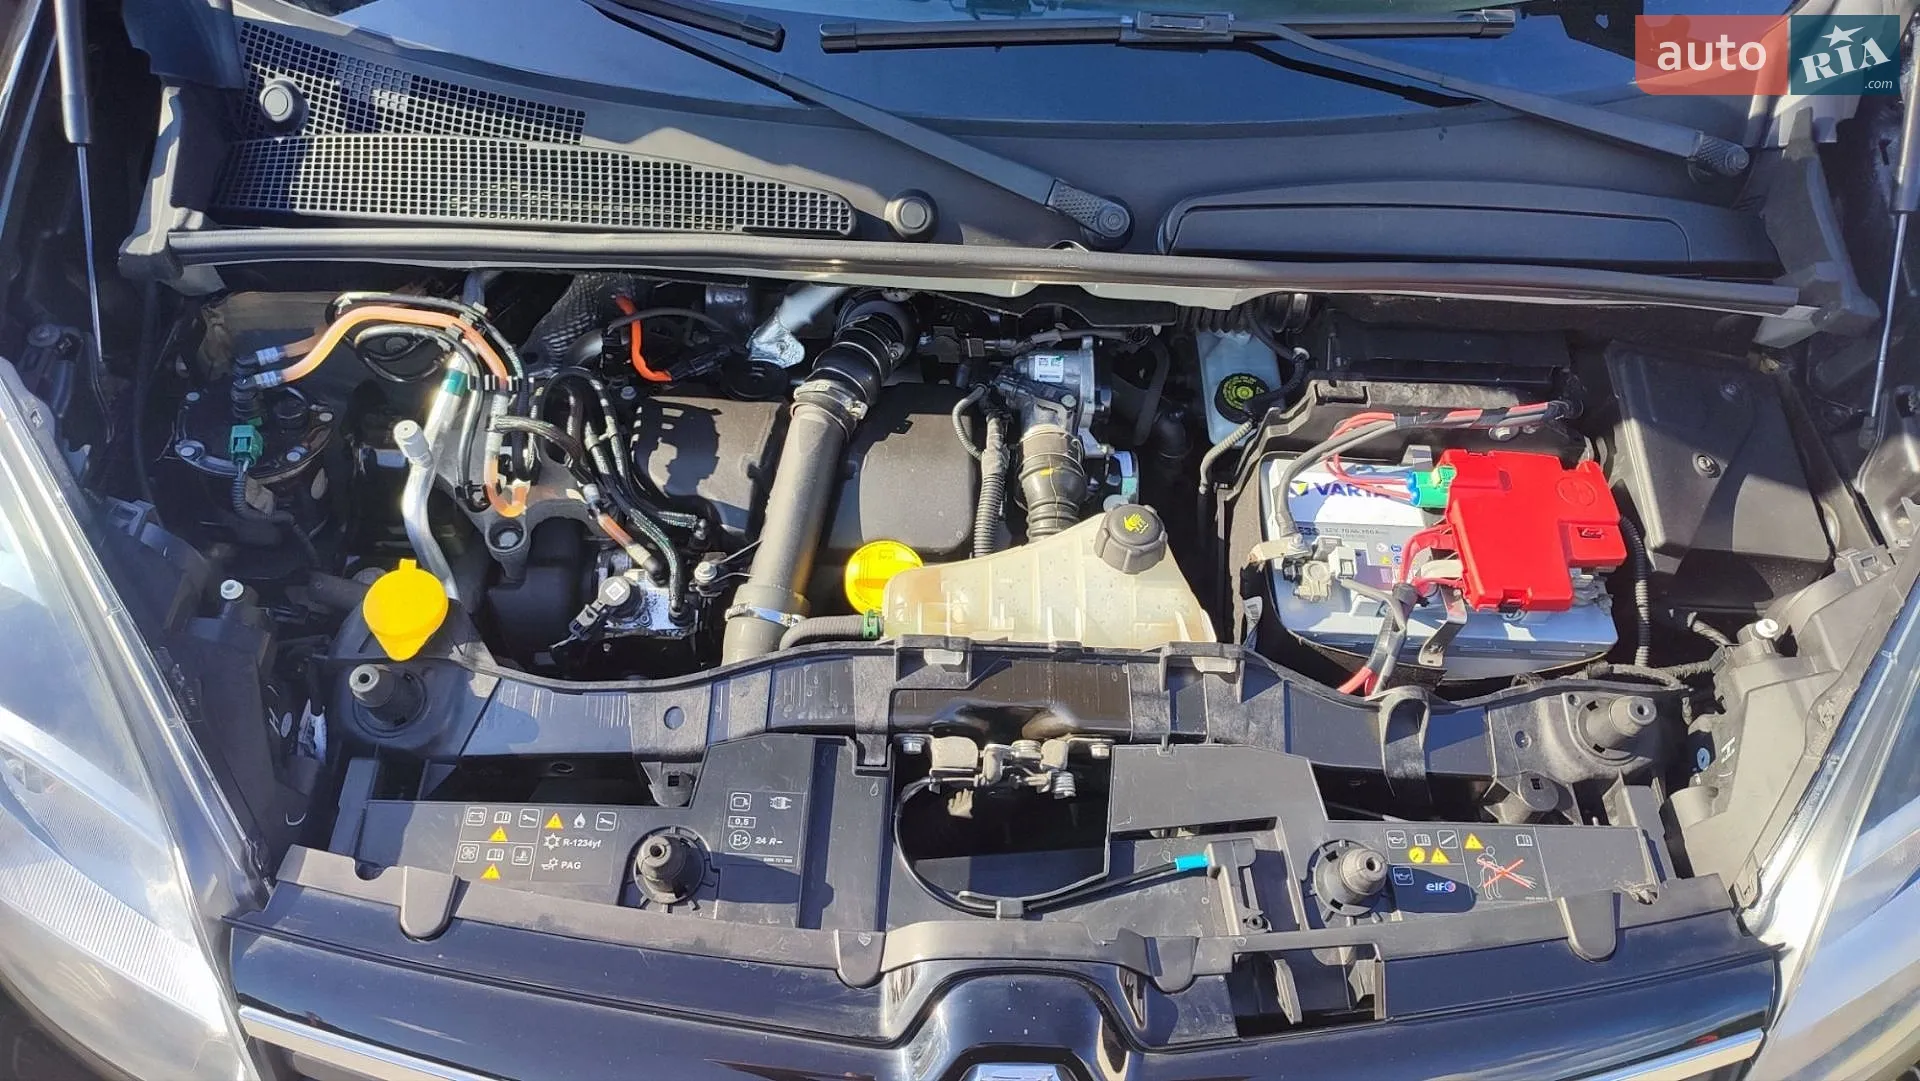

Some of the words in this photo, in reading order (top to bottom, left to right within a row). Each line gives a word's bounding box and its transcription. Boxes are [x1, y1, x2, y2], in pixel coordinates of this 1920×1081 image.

[754, 837, 767, 845] 24
[560, 861, 581, 870] PAG
[1425, 881, 1447, 892] elf
